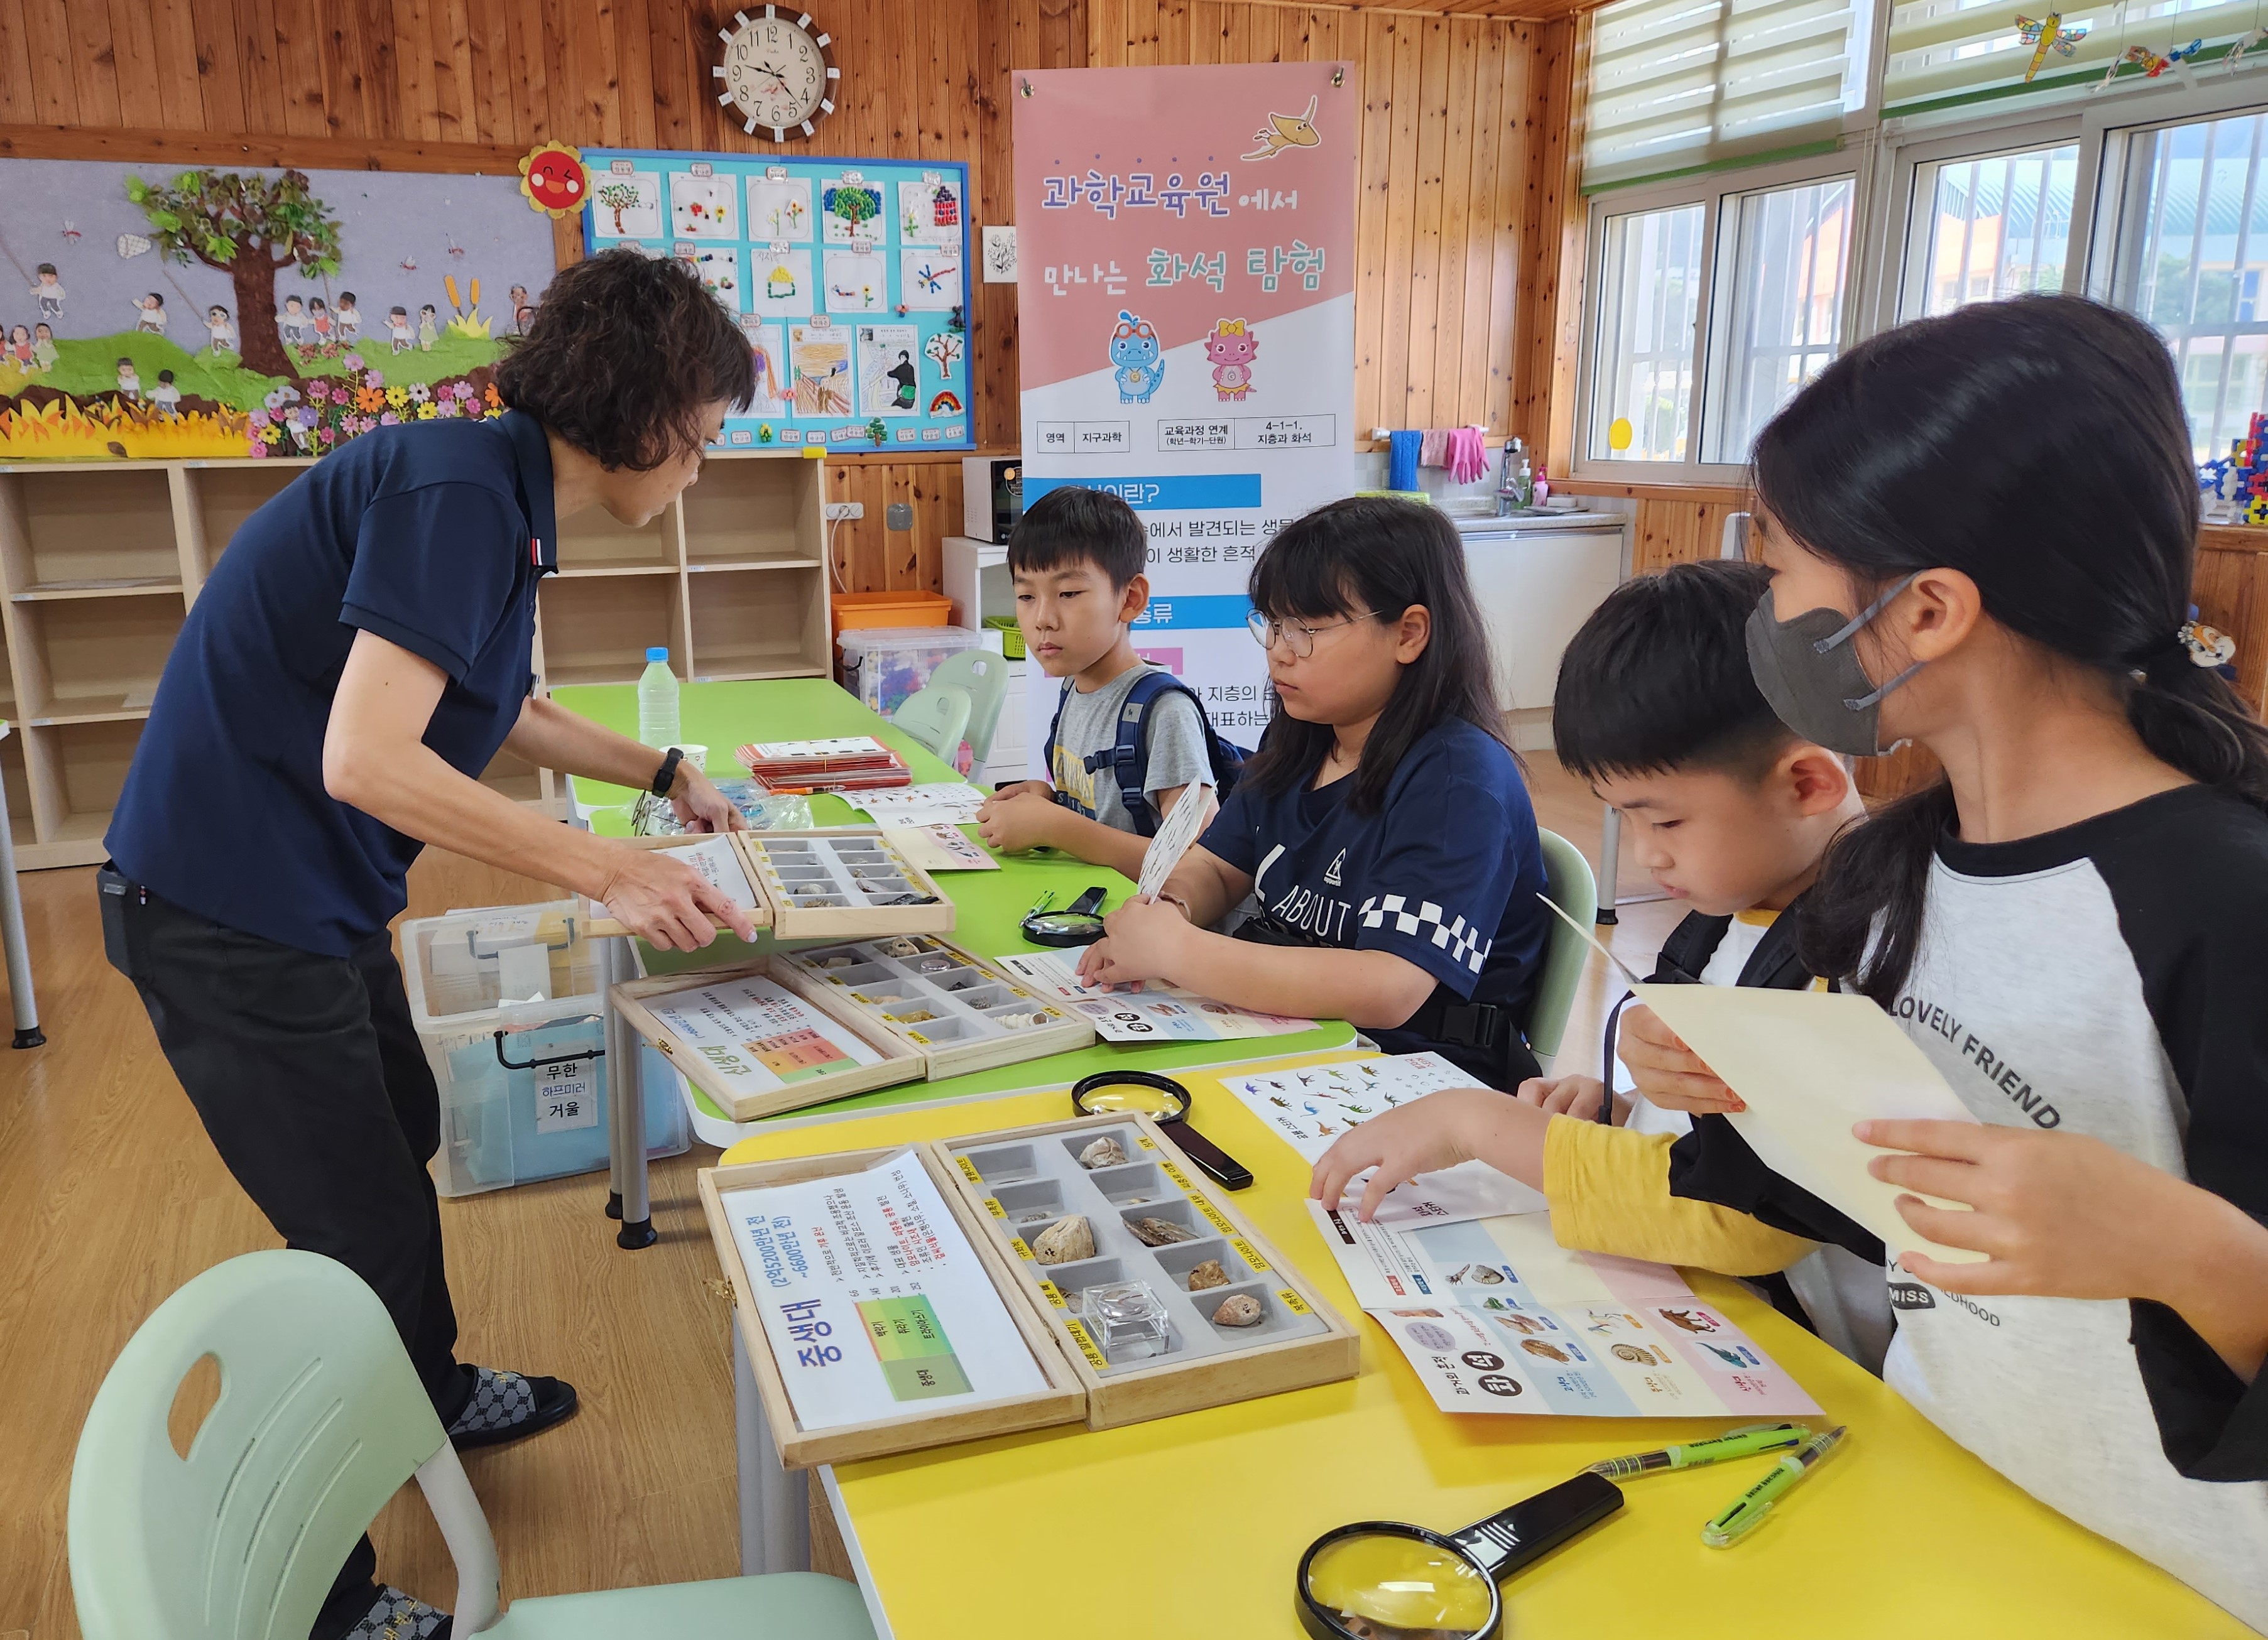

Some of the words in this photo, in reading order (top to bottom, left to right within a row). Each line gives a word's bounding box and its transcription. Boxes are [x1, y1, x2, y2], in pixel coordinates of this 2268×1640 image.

[750, 30, 759, 46] 11
[766, 25, 777, 43] 12
[787, 33, 792, 49] 1
[736, 45, 748, 60] 10
[799, 45, 809, 62] 2
[733, 65, 741, 82] 9
[806, 67, 815, 84] 3
[739, 85, 749, 101] 8
[800, 87, 810, 104] 4
[754, 100, 762, 116] 7
[771, 106, 780, 121] 6
[788, 99, 797, 117] 5
[1042, 168, 1229, 219] 과학교육원
[1239, 190, 1298, 211] 에서
[1045, 261, 1127, 295] 만나는
[1146, 247, 1226, 291] 화석
[1247, 239, 1325, 291] 탐험
[1164, 425, 1206, 436] 교육과정
[1208, 425, 1228, 435] 연계
[1266, 421, 1302, 431] 4-1-1.
[1046, 433, 1065, 443] 영역
[1082, 431, 1122, 443] 지구과학
[1166, 436, 1226, 445] (학년-학기-단원)
[1258, 433, 1287, 444] 지층과
[1291, 432, 1312, 443] 화석
[1144, 521, 1182, 538] 에서
[1189, 519, 1255, 536] 발견되는
[1167, 546, 1218, 563] 생활한
[1208, 685, 1257, 702] 지층의
[1272, 885, 1351, 942] ABOUT
[700, 1043, 751, 1077] 신생대
[1889, 996, 1961, 1043] LOVELY
[1961, 1033, 2061, 1129] FRIEND
[547, 1063, 577, 1080] 무한
[541, 1082, 586, 1099] 하프미러
[550, 1102, 580, 1118] 거울
[1275, 1116, 1298, 1131] 스티커
[983, 1200, 1001, 1217] 부족류
[1191, 1195, 1207, 1205] 내부
[1422, 1202, 1448, 1215] 스티커
[882, 1206, 896, 1218] 공룡
[1203, 1206, 1231, 1232] 암모나이트
[1411, 1206, 1432, 1216] 화석
[745, 1214, 765, 1226] 전
[770, 1215, 792, 1230] 전)
[817, 1237, 829, 1249] 기후
[907, 1227, 924, 1244] 시조새
[777, 1230, 812, 1279] ~6600만년
[898, 1237, 920, 1266] 암모나이트,
[916, 1246, 934, 1263] 조류인
[1009, 1240, 1028, 1257] 규화목
[1235, 1238, 1263, 1270] 암모나이트
[751, 1227, 790, 1288] (2억5200만년
[822, 1249, 841, 1275] 전반적으로
[893, 1257, 907, 1268] 대표
[849, 1288, 859, 1298] 66
[1045, 1293, 1061, 1306] 공룡
[1282, 1290, 1304, 1312] 복족류
[1888, 1286, 1929, 1304] MISS
[871, 1320, 888, 1337] 백악기
[892, 1317, 910, 1335] 쥐라기
[910, 1308, 936, 1340] 트라이아스기
[782, 1298, 842, 1369] 중생대
[1065, 1322, 1091, 1350] 알껍데기
[1085, 1352, 1103, 1367] 공룡
[1431, 1356, 1456, 1369] 흔적
[916, 1369, 935, 1387] 중생대
[1442, 1372, 1471, 1394] 과거의
[1554, 1376, 1576, 1391] 고생대
